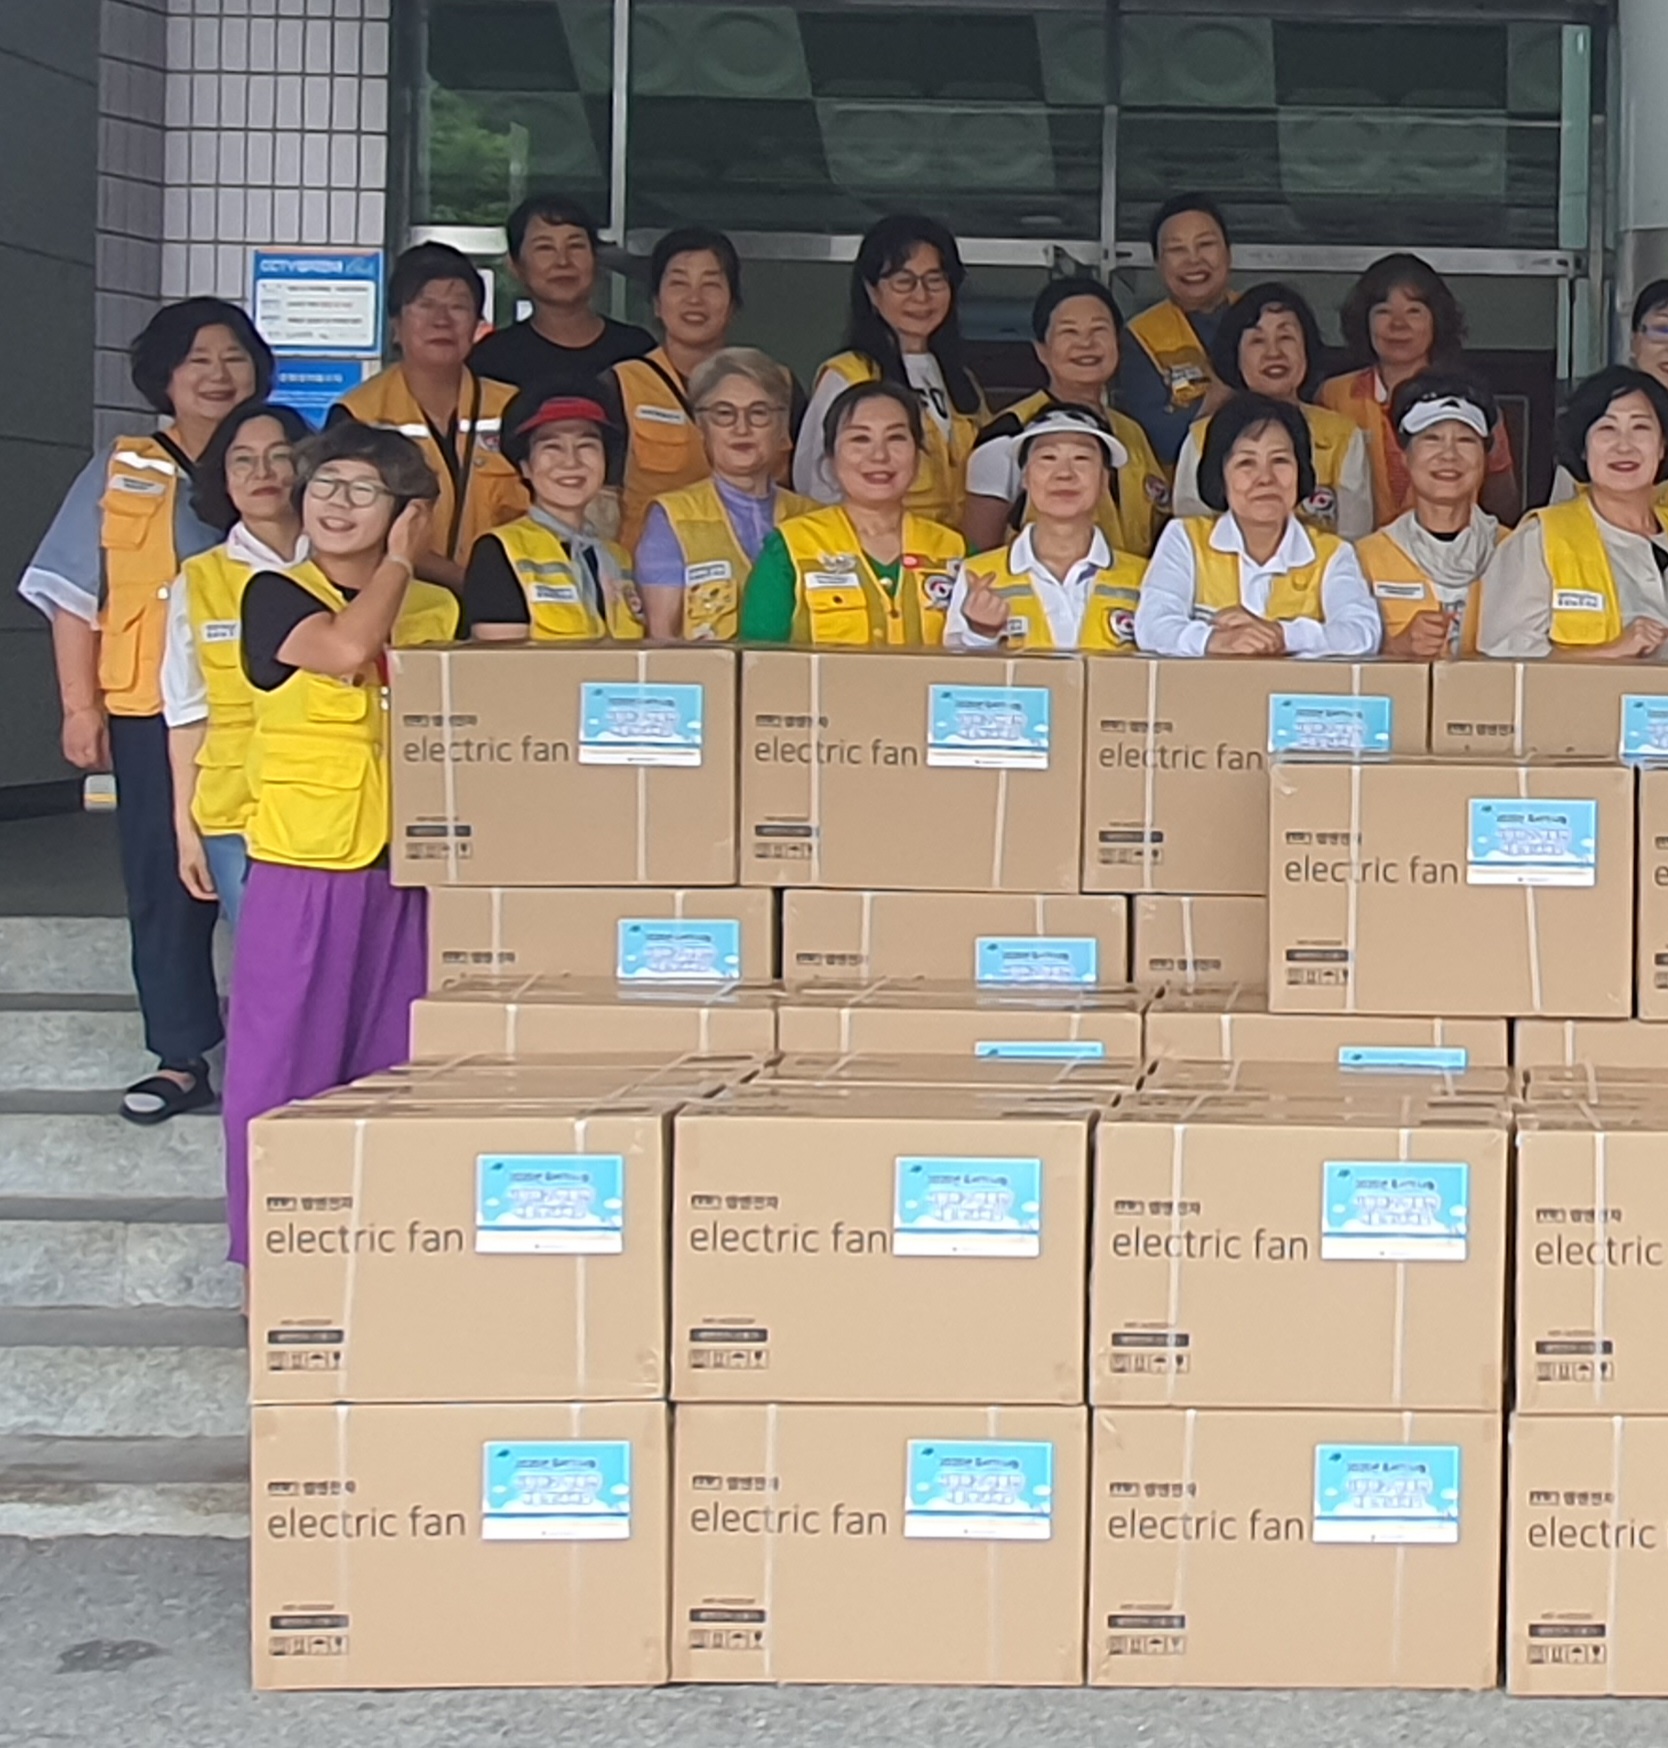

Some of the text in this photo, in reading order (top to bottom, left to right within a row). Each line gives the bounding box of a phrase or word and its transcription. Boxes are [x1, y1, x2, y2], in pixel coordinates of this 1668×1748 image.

[404, 735, 568, 762] electric fan
[755, 736, 917, 766] electric fan
[1100, 742, 1263, 771] electric fan
[1285, 854, 1458, 884] elecric fan
[266, 1221, 463, 1254] electric fan
[691, 1220, 887, 1253] electric fan
[1113, 1226, 1307, 1260] electric fan
[1536, 1234, 1662, 1266] electric
[268, 1505, 465, 1539] electric fan
[691, 1501, 886, 1535] electric fan
[1108, 1508, 1303, 1541] electric fan
[1529, 1516, 1656, 1549] electric
